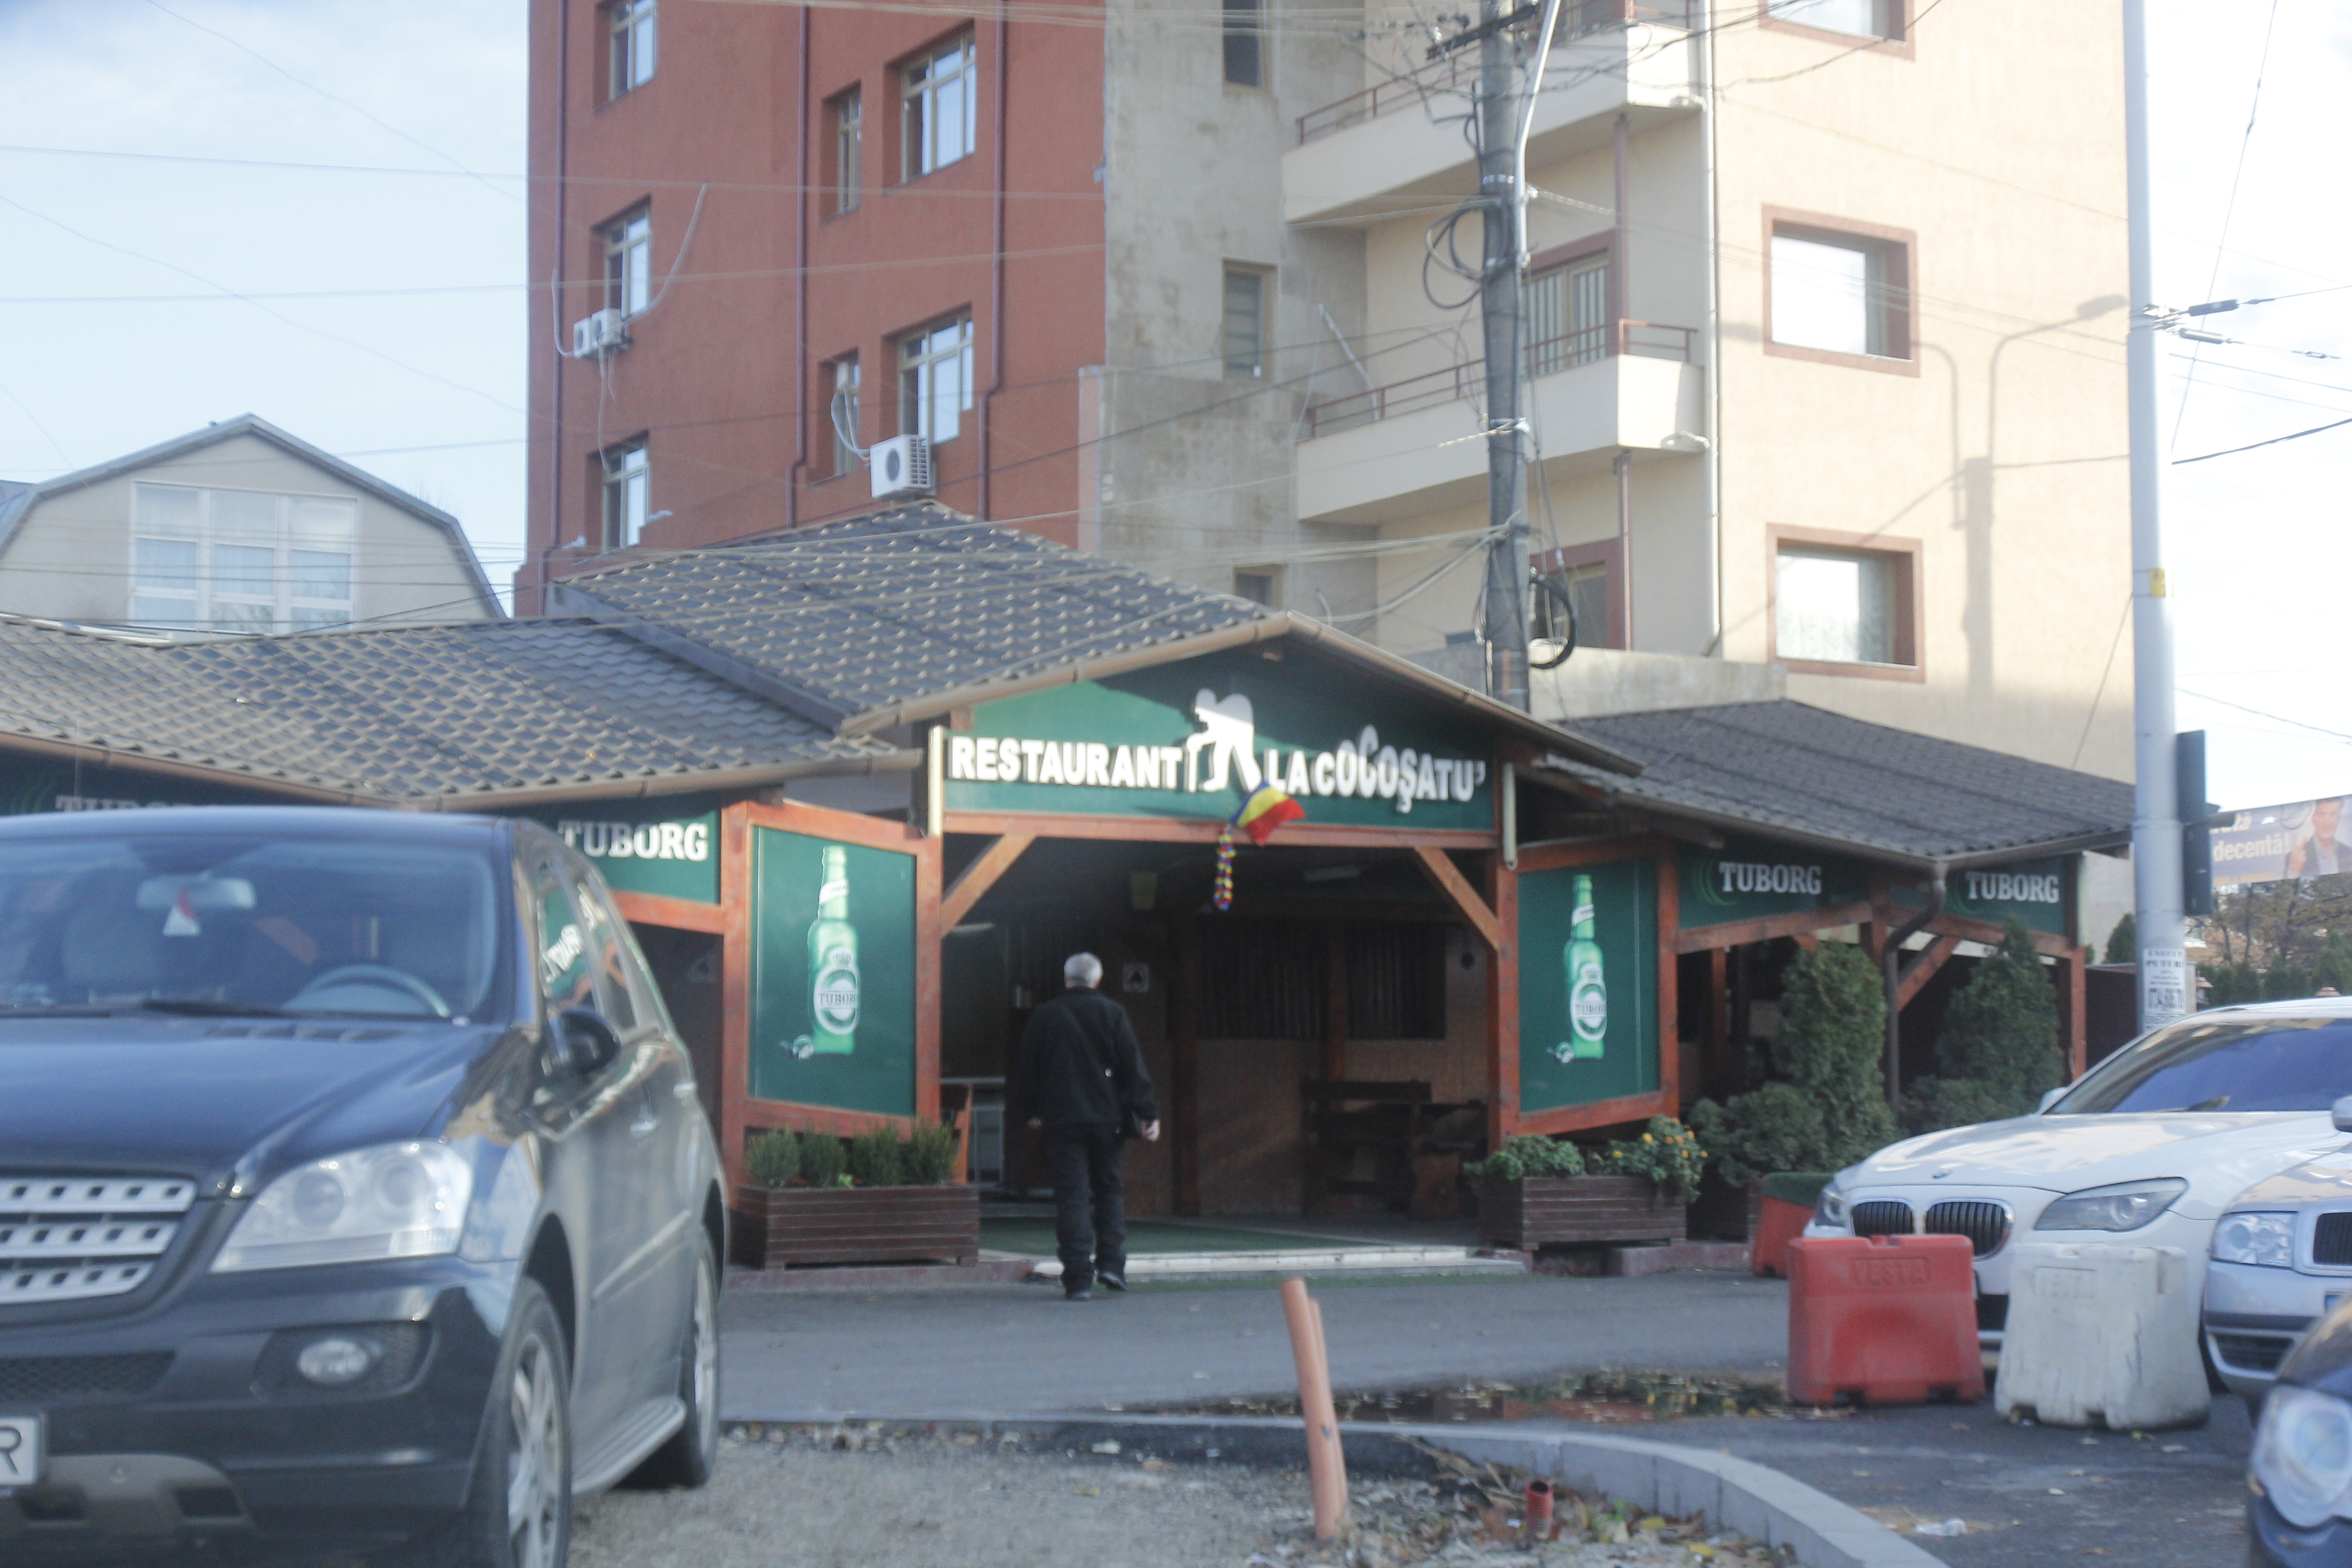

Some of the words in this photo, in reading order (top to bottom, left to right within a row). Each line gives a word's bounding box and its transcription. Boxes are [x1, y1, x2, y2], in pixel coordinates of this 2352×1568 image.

[949, 736, 1183, 790] RESTAURANT
[1264, 749, 1311, 795] LA
[558, 819, 709, 862] TUBORG
[1719, 862, 1822, 894] TUBORG
[1965, 872, 2059, 903] TUBORG
